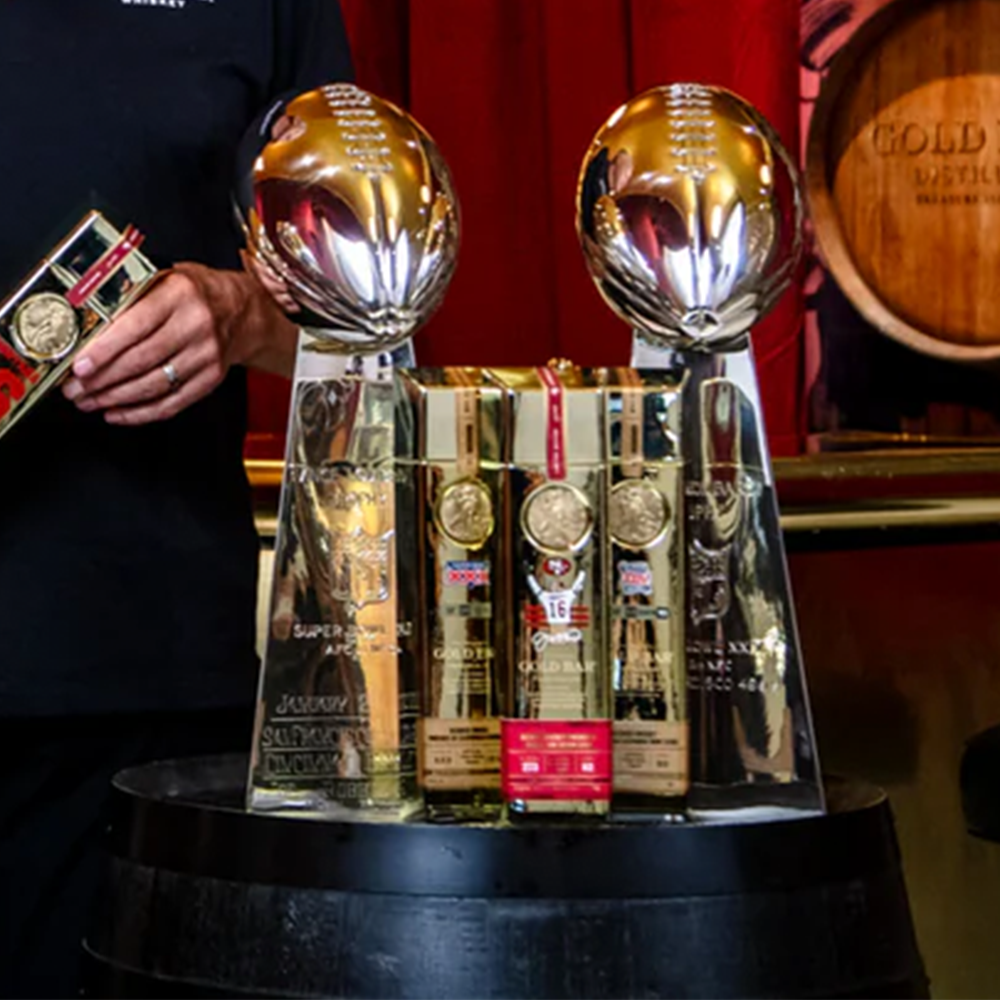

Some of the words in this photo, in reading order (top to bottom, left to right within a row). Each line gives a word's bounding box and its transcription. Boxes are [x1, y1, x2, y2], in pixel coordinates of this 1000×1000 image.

[873, 121, 987, 156] GOLD
[549, 600, 566, 618] 16
[293, 623, 342, 639] SUPER
